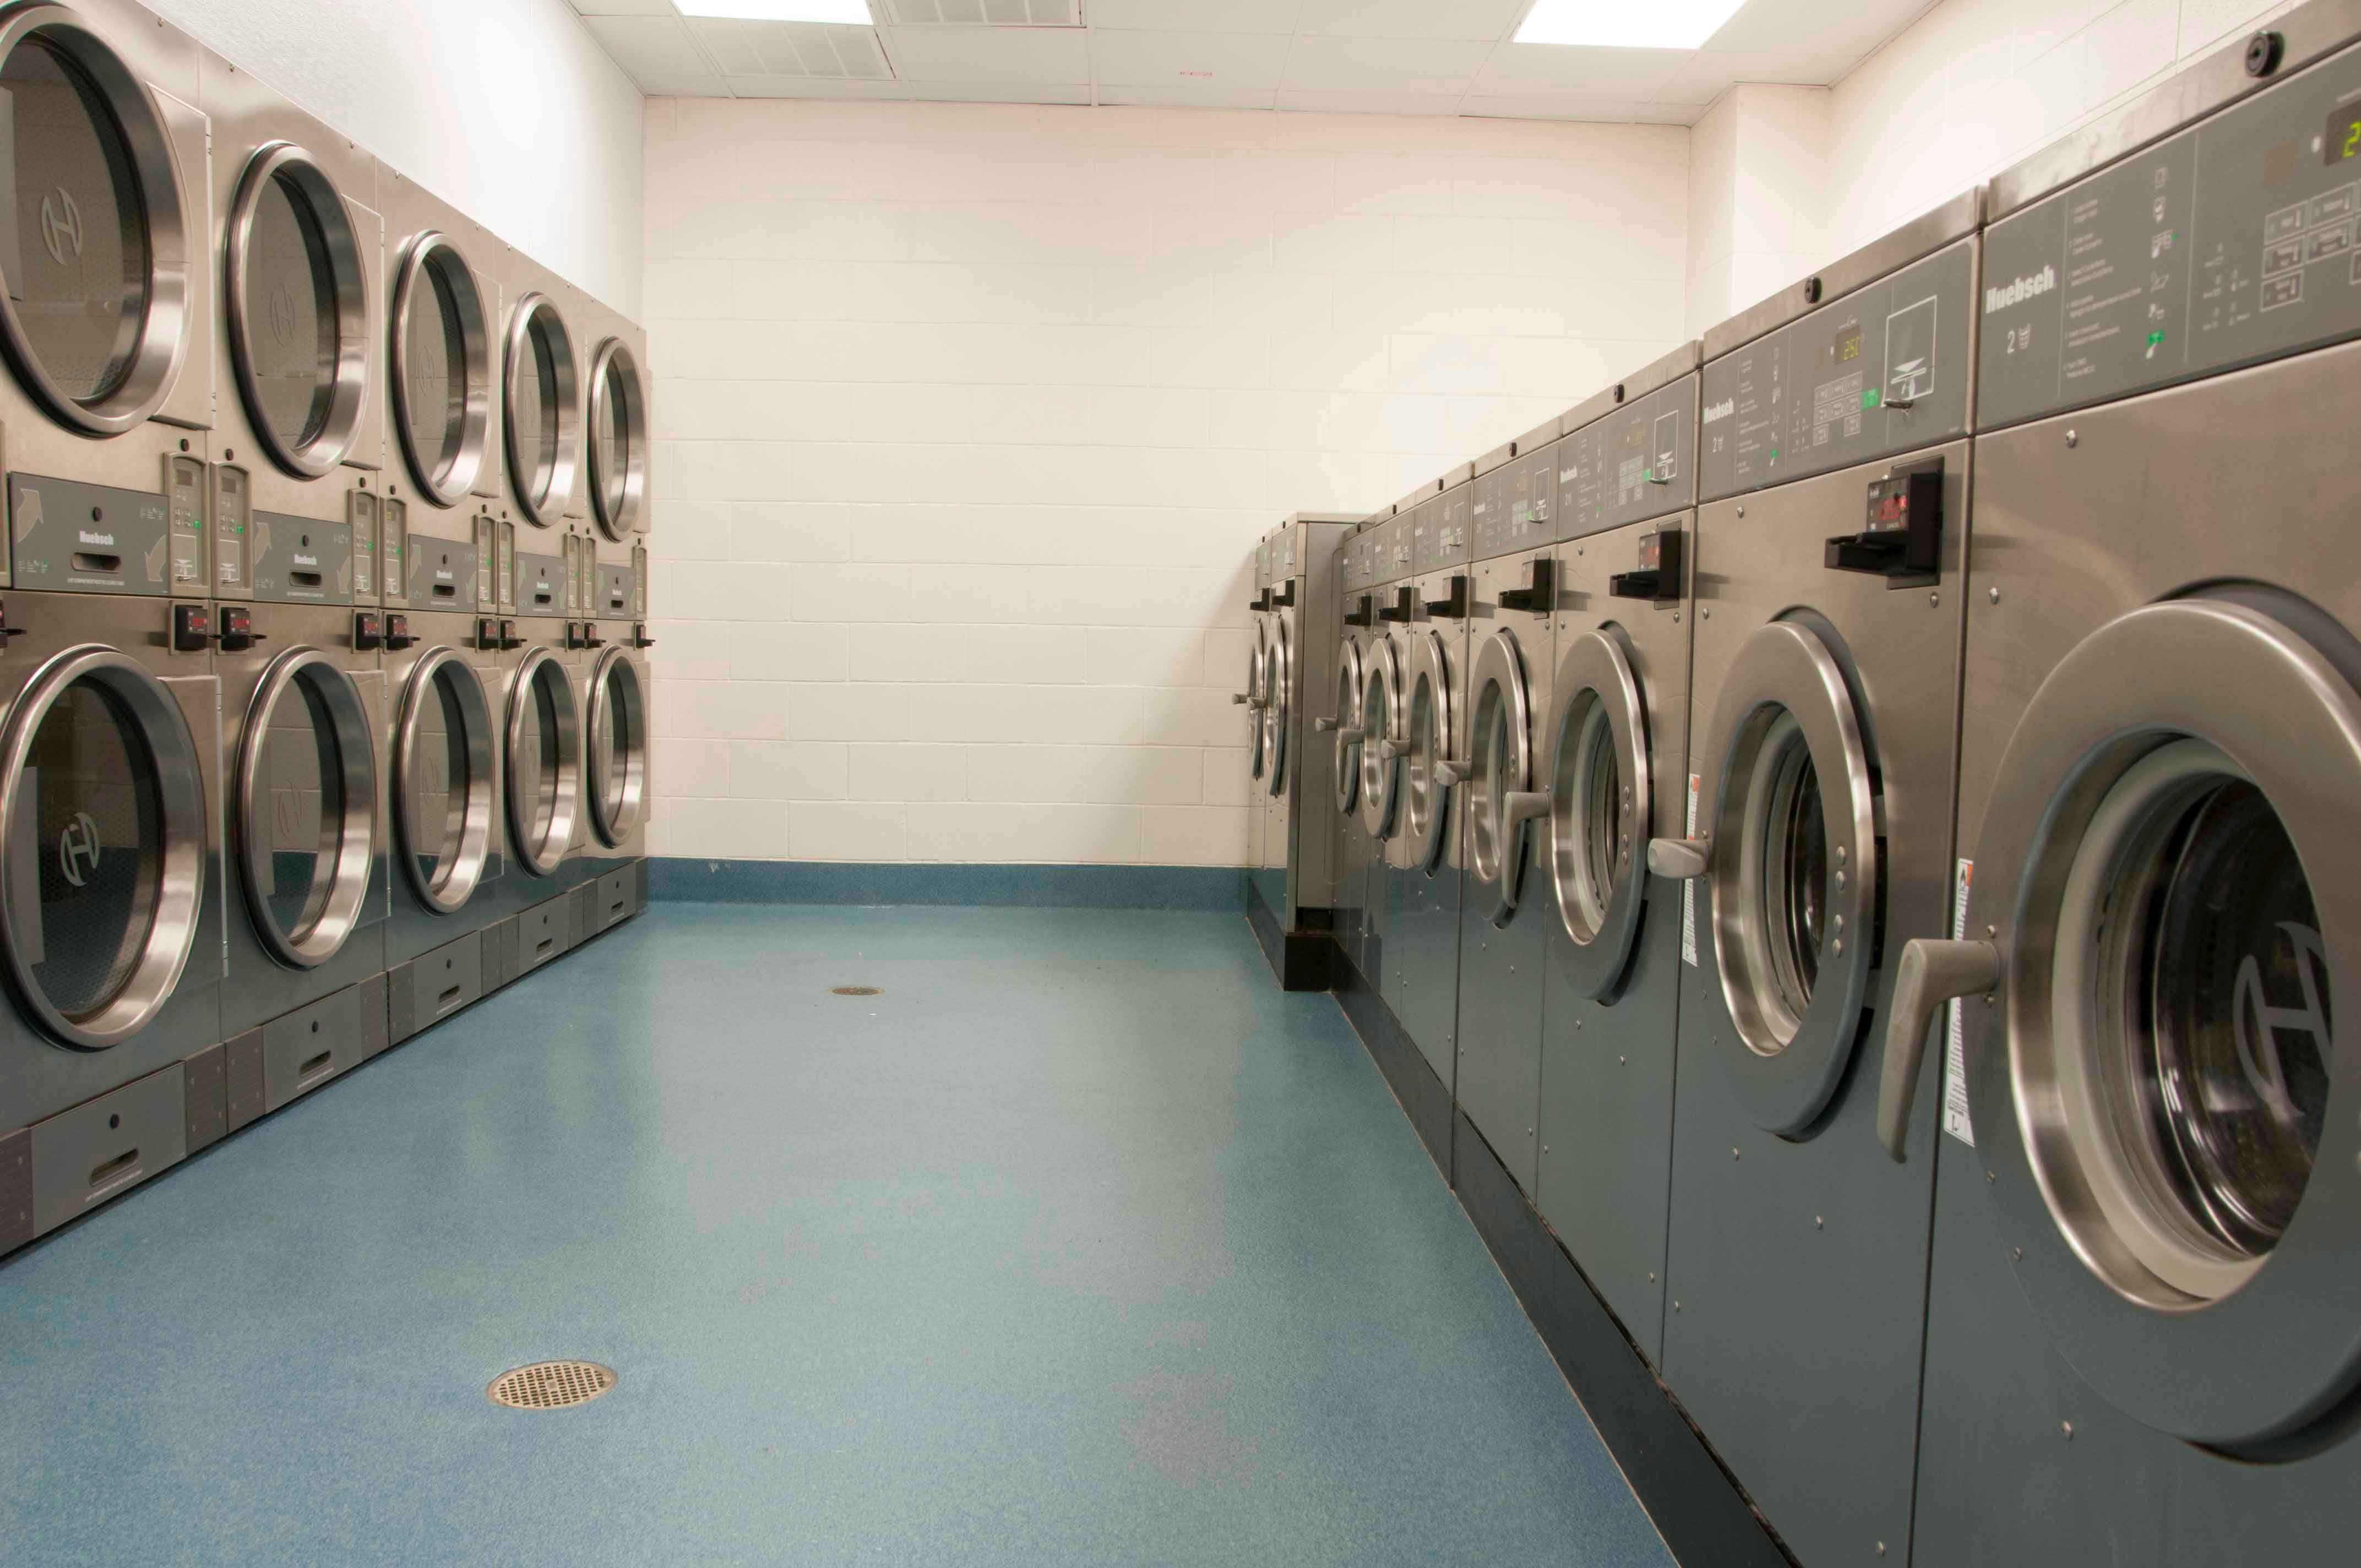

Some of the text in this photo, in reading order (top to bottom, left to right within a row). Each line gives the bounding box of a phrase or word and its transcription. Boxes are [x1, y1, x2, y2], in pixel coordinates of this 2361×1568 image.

[1986, 265, 2054, 314] Huebsch
[2007, 330, 2015, 354] 2
[79, 530, 115, 546] Huebsch
